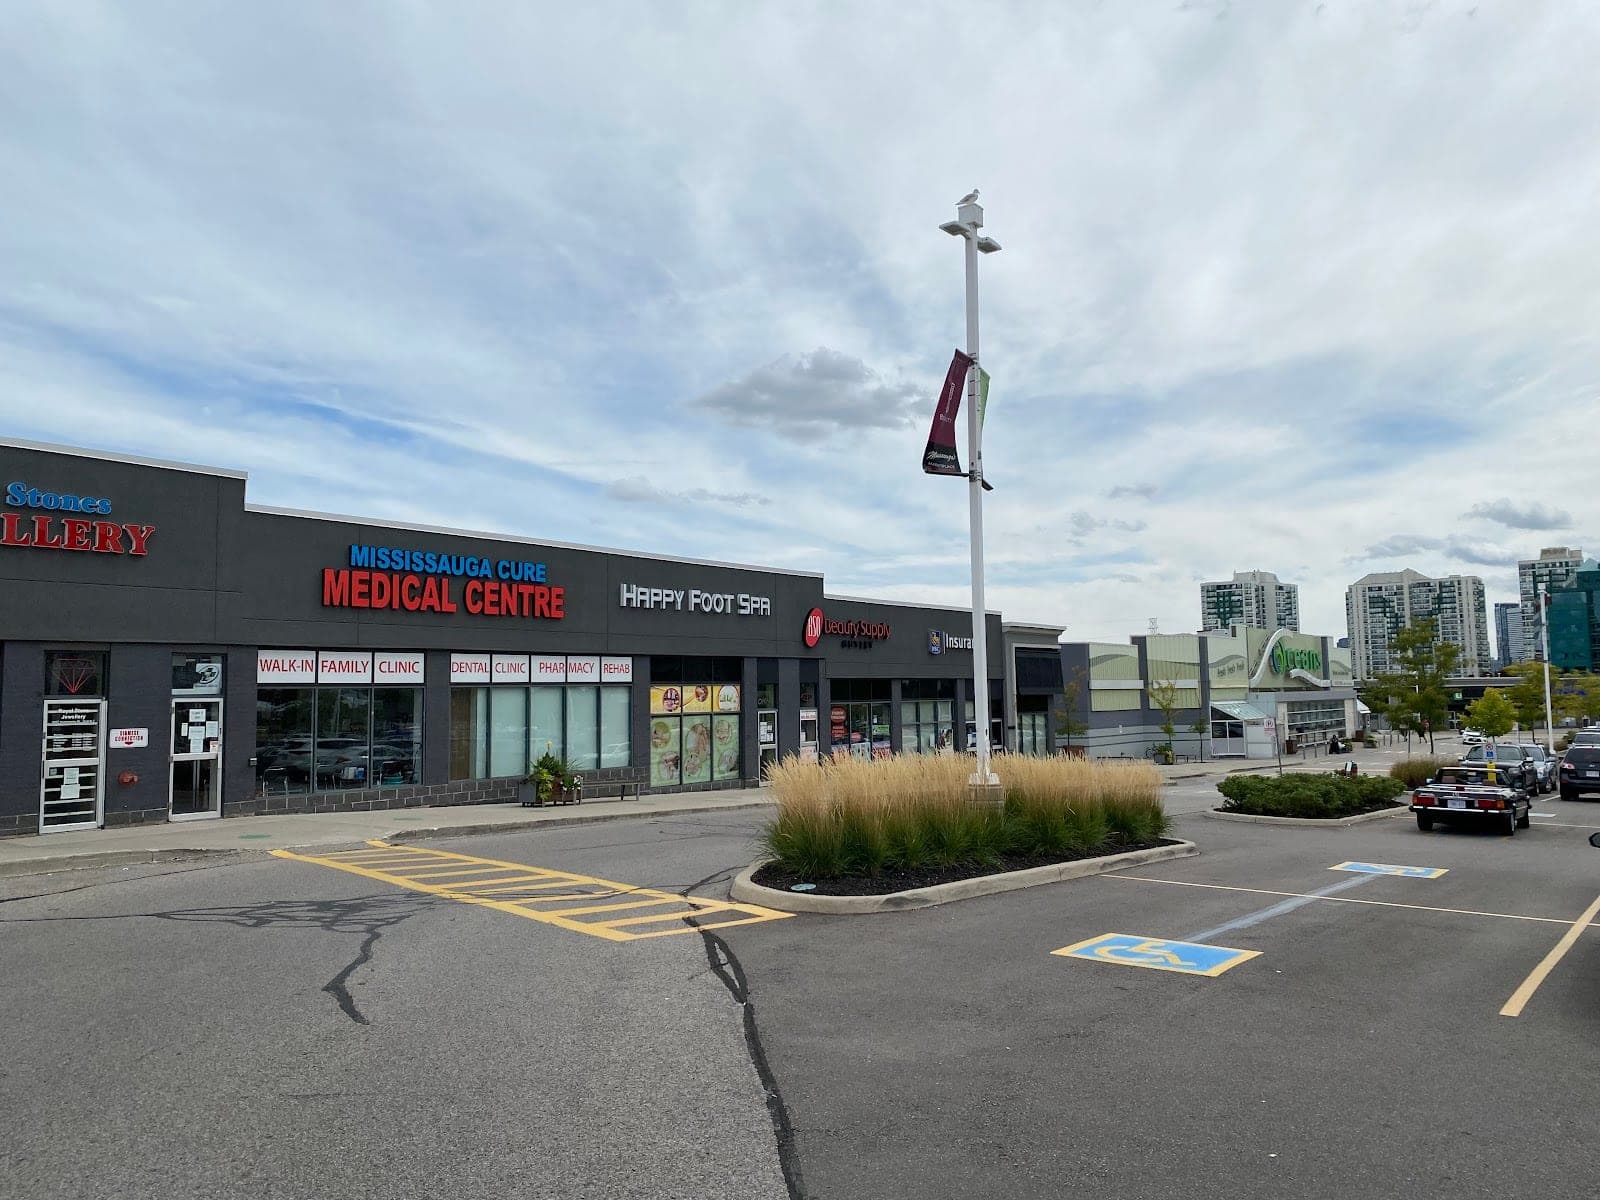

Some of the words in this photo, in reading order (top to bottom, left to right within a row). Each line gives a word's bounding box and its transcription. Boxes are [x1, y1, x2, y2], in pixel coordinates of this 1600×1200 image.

[6, 481, 112, 514] Stones
[0, 512, 155, 556] LLERY
[350, 543, 492, 579] MISSISSAUGA
[497, 559, 547, 583] CURE
[322, 568, 457, 613] MEDICAL
[464, 580, 566, 619] CENTRE
[619, 583, 685, 611] HAPPY
[688, 589, 735, 615] FOOT
[737, 593, 771, 616] SPA
[808, 615, 821, 638] BSO
[824, 619, 859, 638] Beauty
[860, 621, 891, 640] Supply
[945, 633, 974, 649] Insura
[259, 658, 314, 675] WALK-IN
[320, 659, 369, 675] FAMILY
[378, 660, 420, 675] CLINIC
[451, 661, 490, 674] DENTAL
[495, 661, 526, 675] CLINIC
[603, 663, 630, 674] REHAB
[1271, 639, 1321, 674] Oceans
